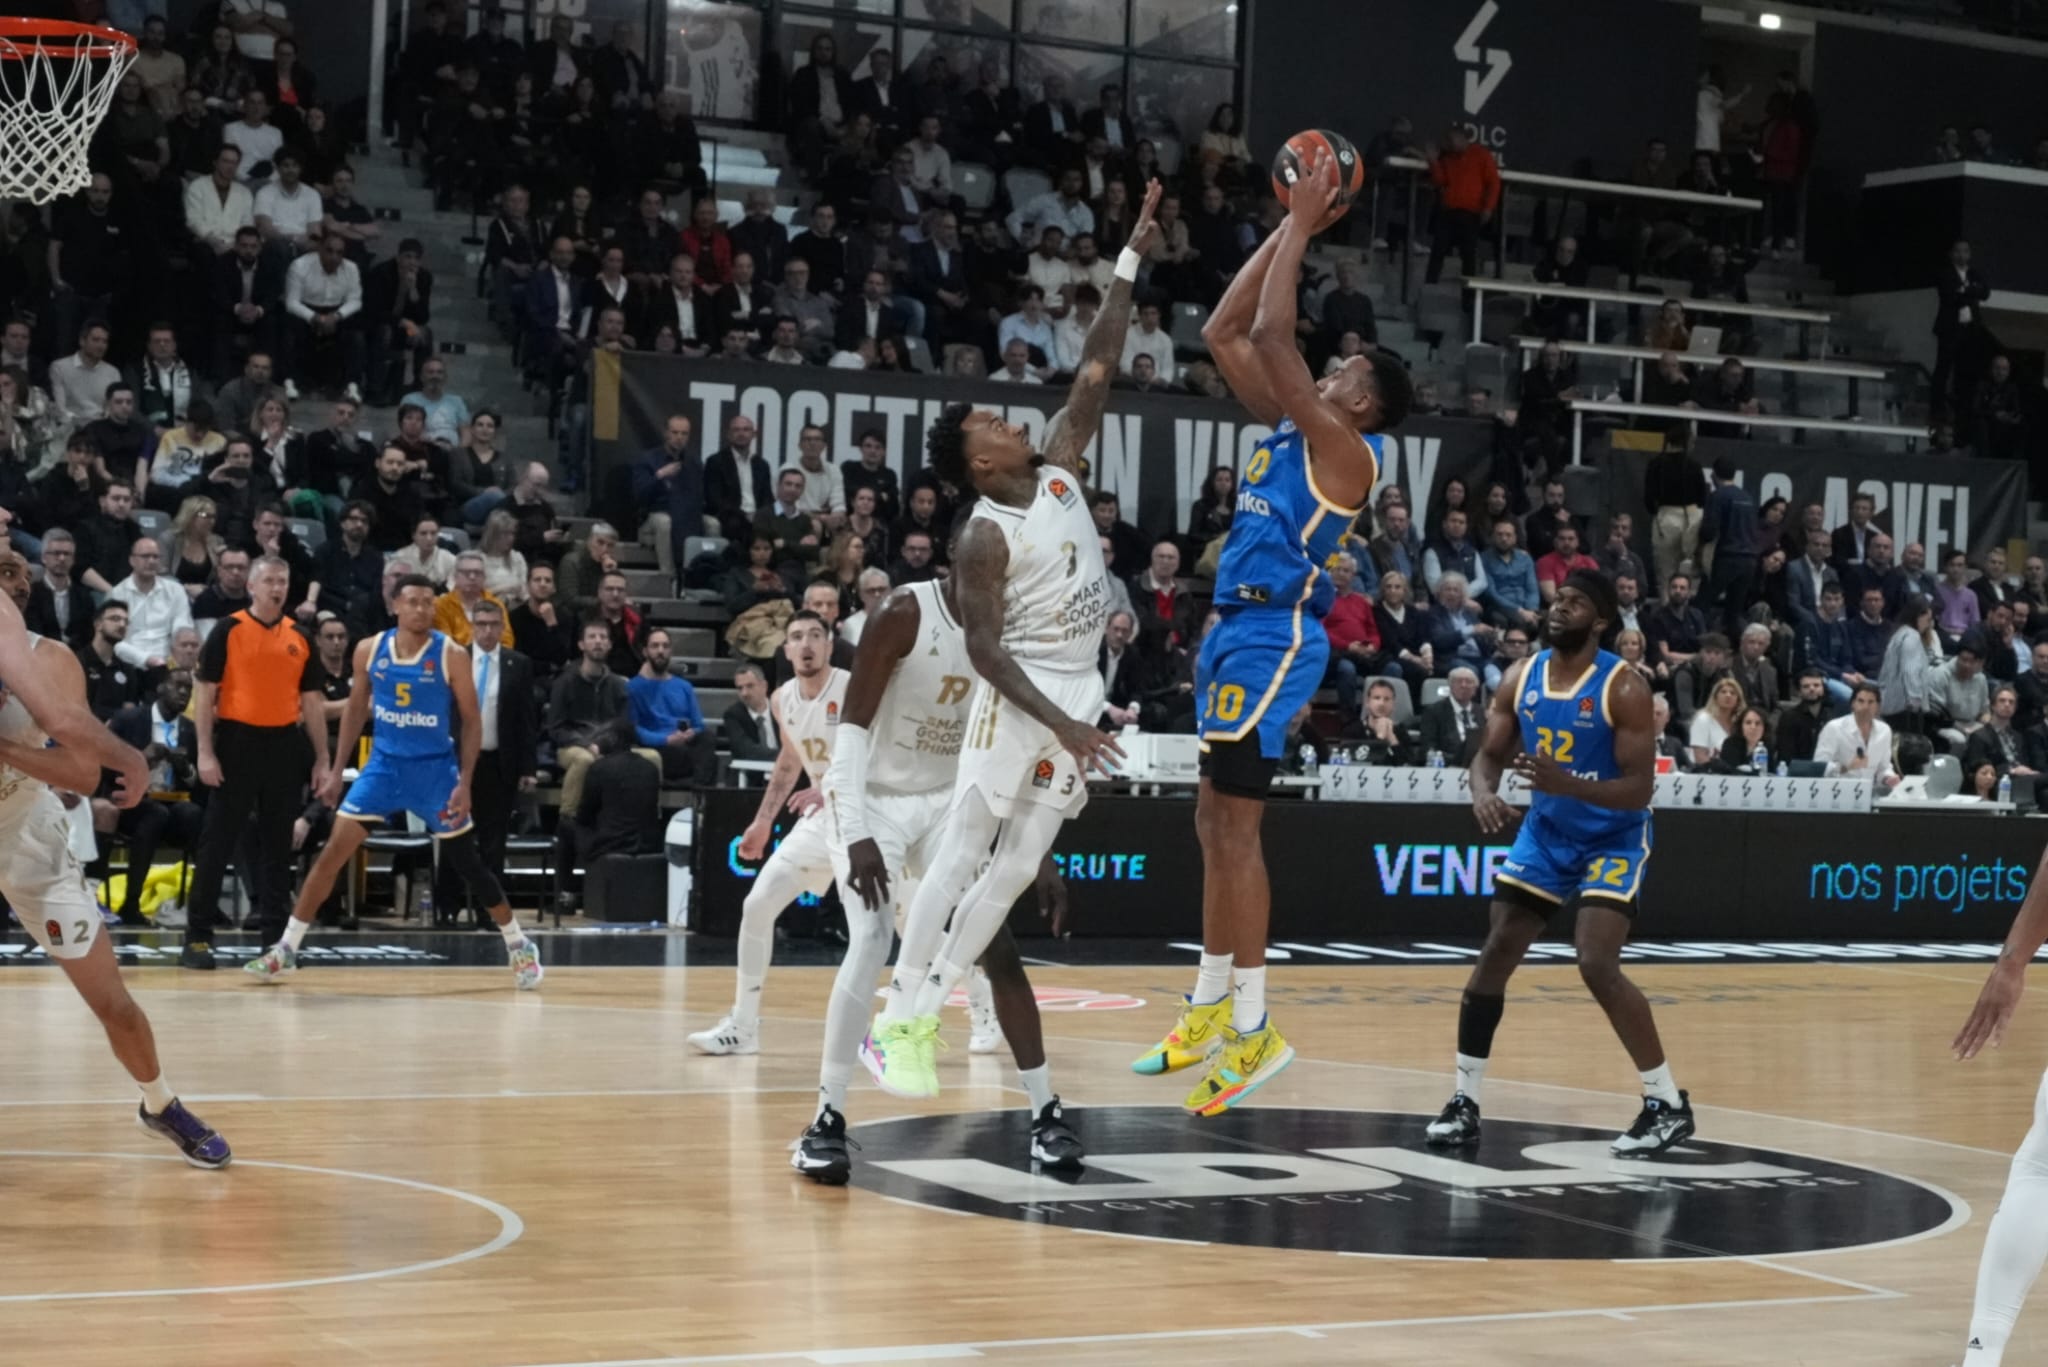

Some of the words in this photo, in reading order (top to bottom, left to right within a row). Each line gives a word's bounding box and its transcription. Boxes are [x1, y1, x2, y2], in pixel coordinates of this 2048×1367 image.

[1453, 122, 1506, 148] DLC
[1062, 611, 1106, 642] THING
[395, 683, 411, 707] 5
[375, 704, 439, 728] Playtika
[802, 737, 830, 761] 12
[916, 740, 962, 756] THING
[1061, 773, 1076, 796] 3
[1811, 862, 1882, 900] nos
[1894, 854, 2028, 912] projets
[73, 920, 90, 944] 2
